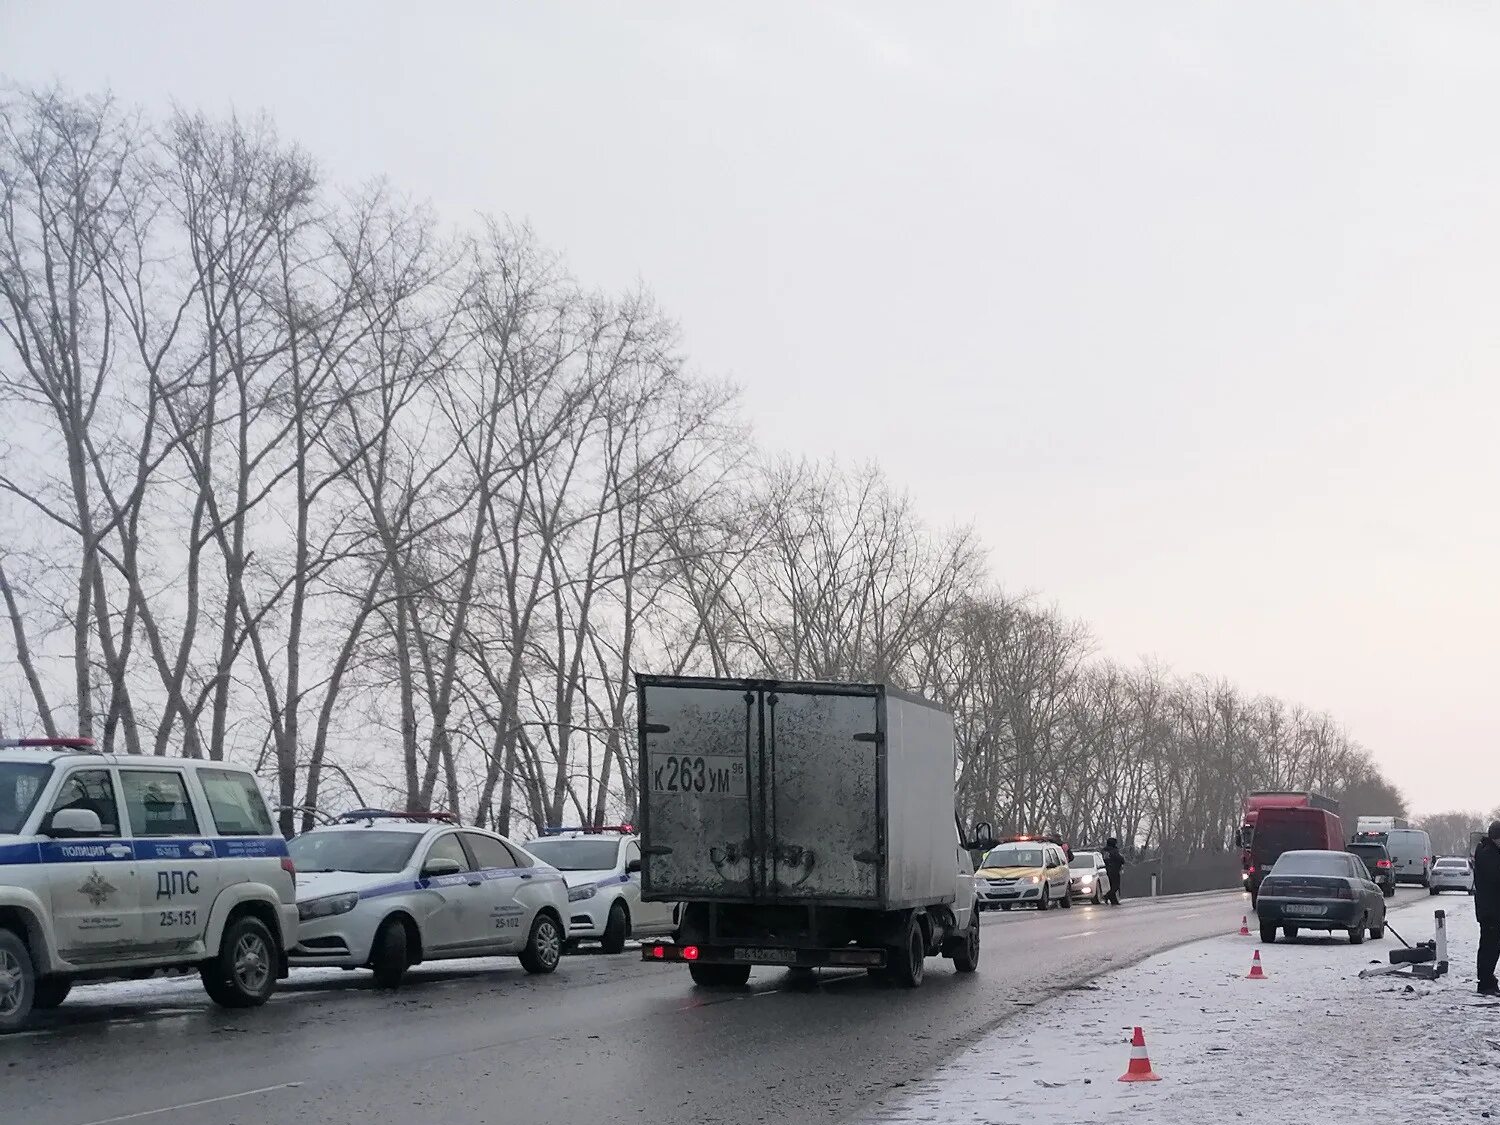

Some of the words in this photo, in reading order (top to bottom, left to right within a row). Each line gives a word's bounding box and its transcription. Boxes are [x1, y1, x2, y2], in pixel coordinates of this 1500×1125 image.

[62, 845, 106, 857] ПОЛИЦИЯ
[156, 870, 200, 900] ДПС
[160, 910, 197, 927] 25-151
